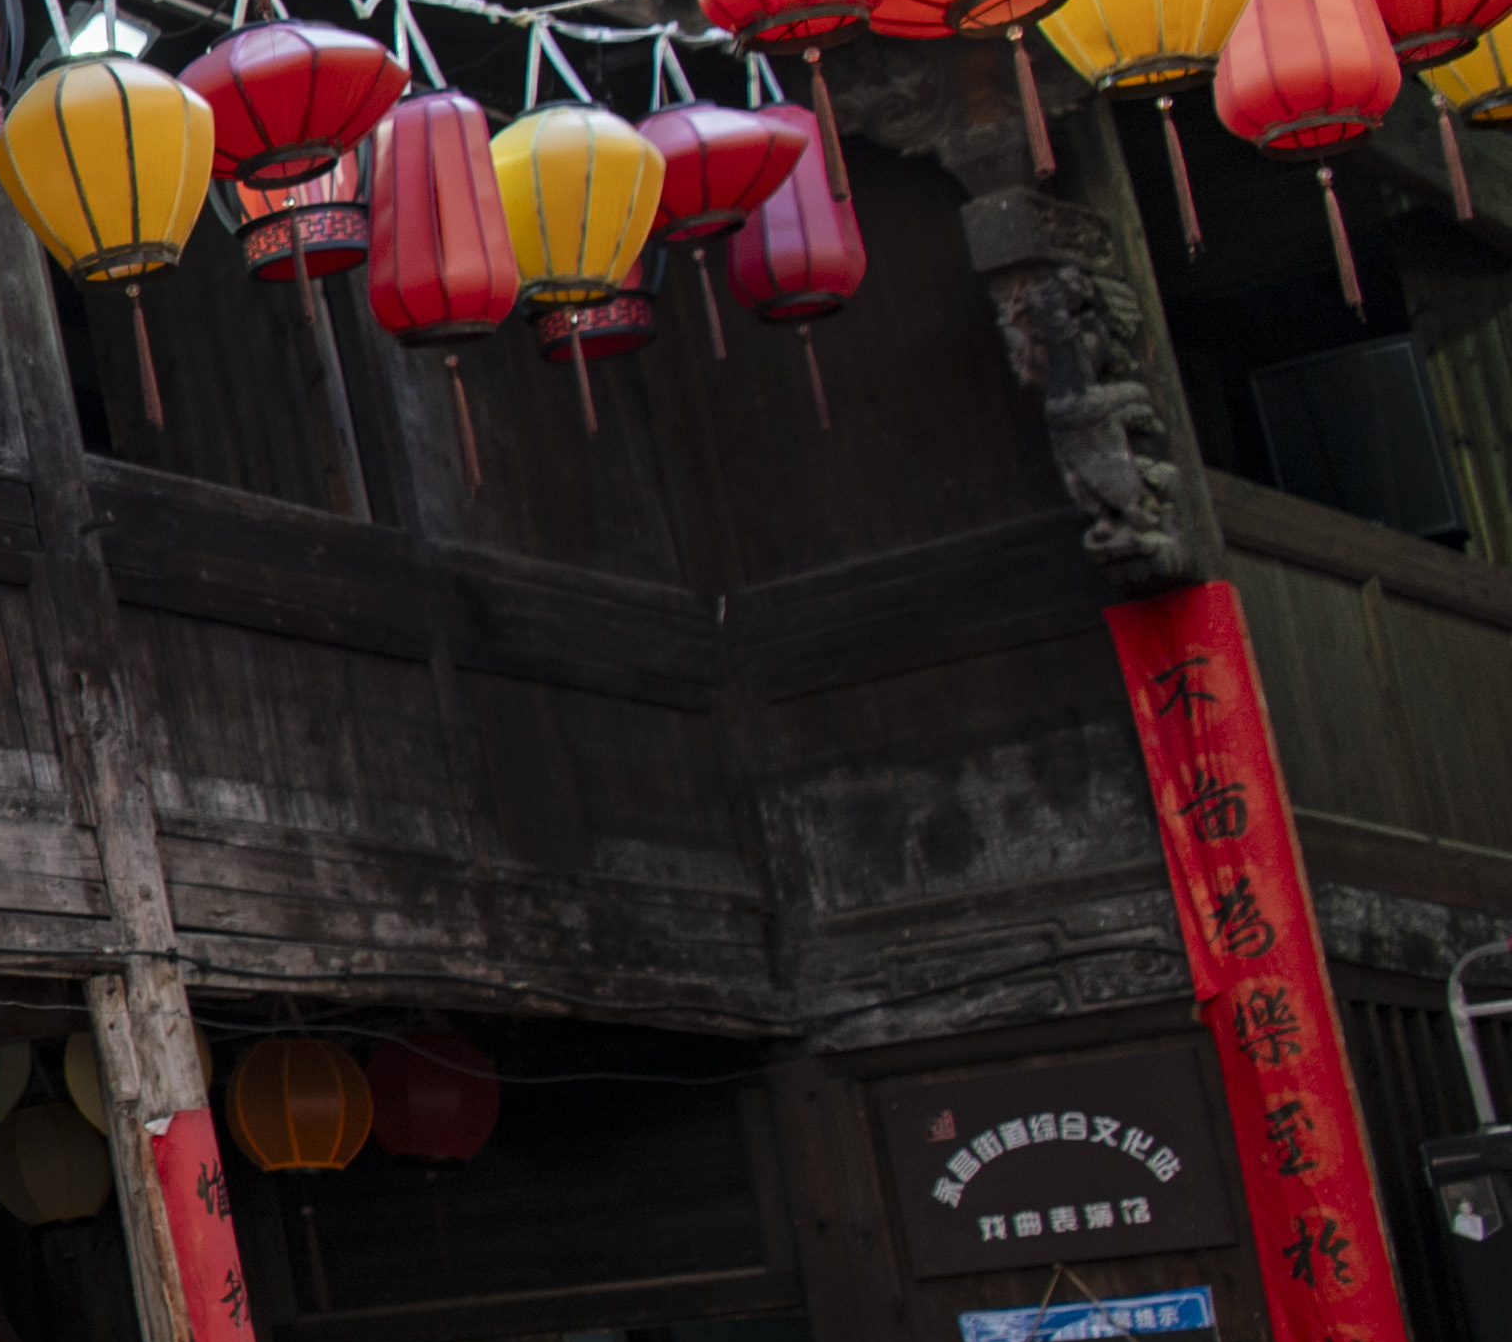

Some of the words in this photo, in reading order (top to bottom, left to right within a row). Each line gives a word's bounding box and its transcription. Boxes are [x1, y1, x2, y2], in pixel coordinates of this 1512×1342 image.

[931, 1111, 1183, 1209] 永昌街道综合文化站
[977, 1196, 1152, 1241] 戏曲表演馆
